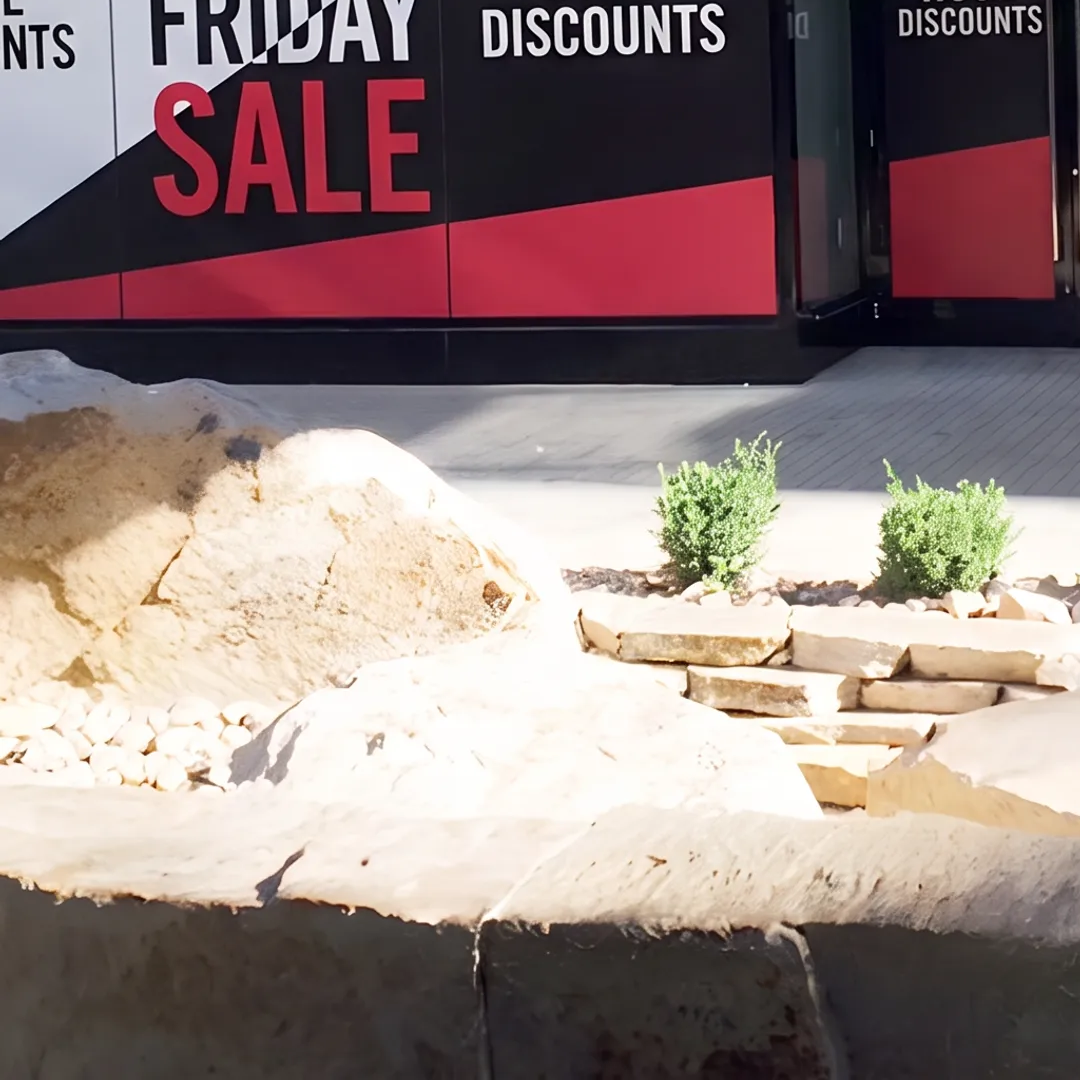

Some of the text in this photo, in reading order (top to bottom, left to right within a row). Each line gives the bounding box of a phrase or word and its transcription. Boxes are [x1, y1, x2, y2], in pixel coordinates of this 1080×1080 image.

[482, 3, 726, 58] DISCOUNTS
[898, 5, 1042, 37] DISCOUNTS
[153, 78, 431, 216] SALE
